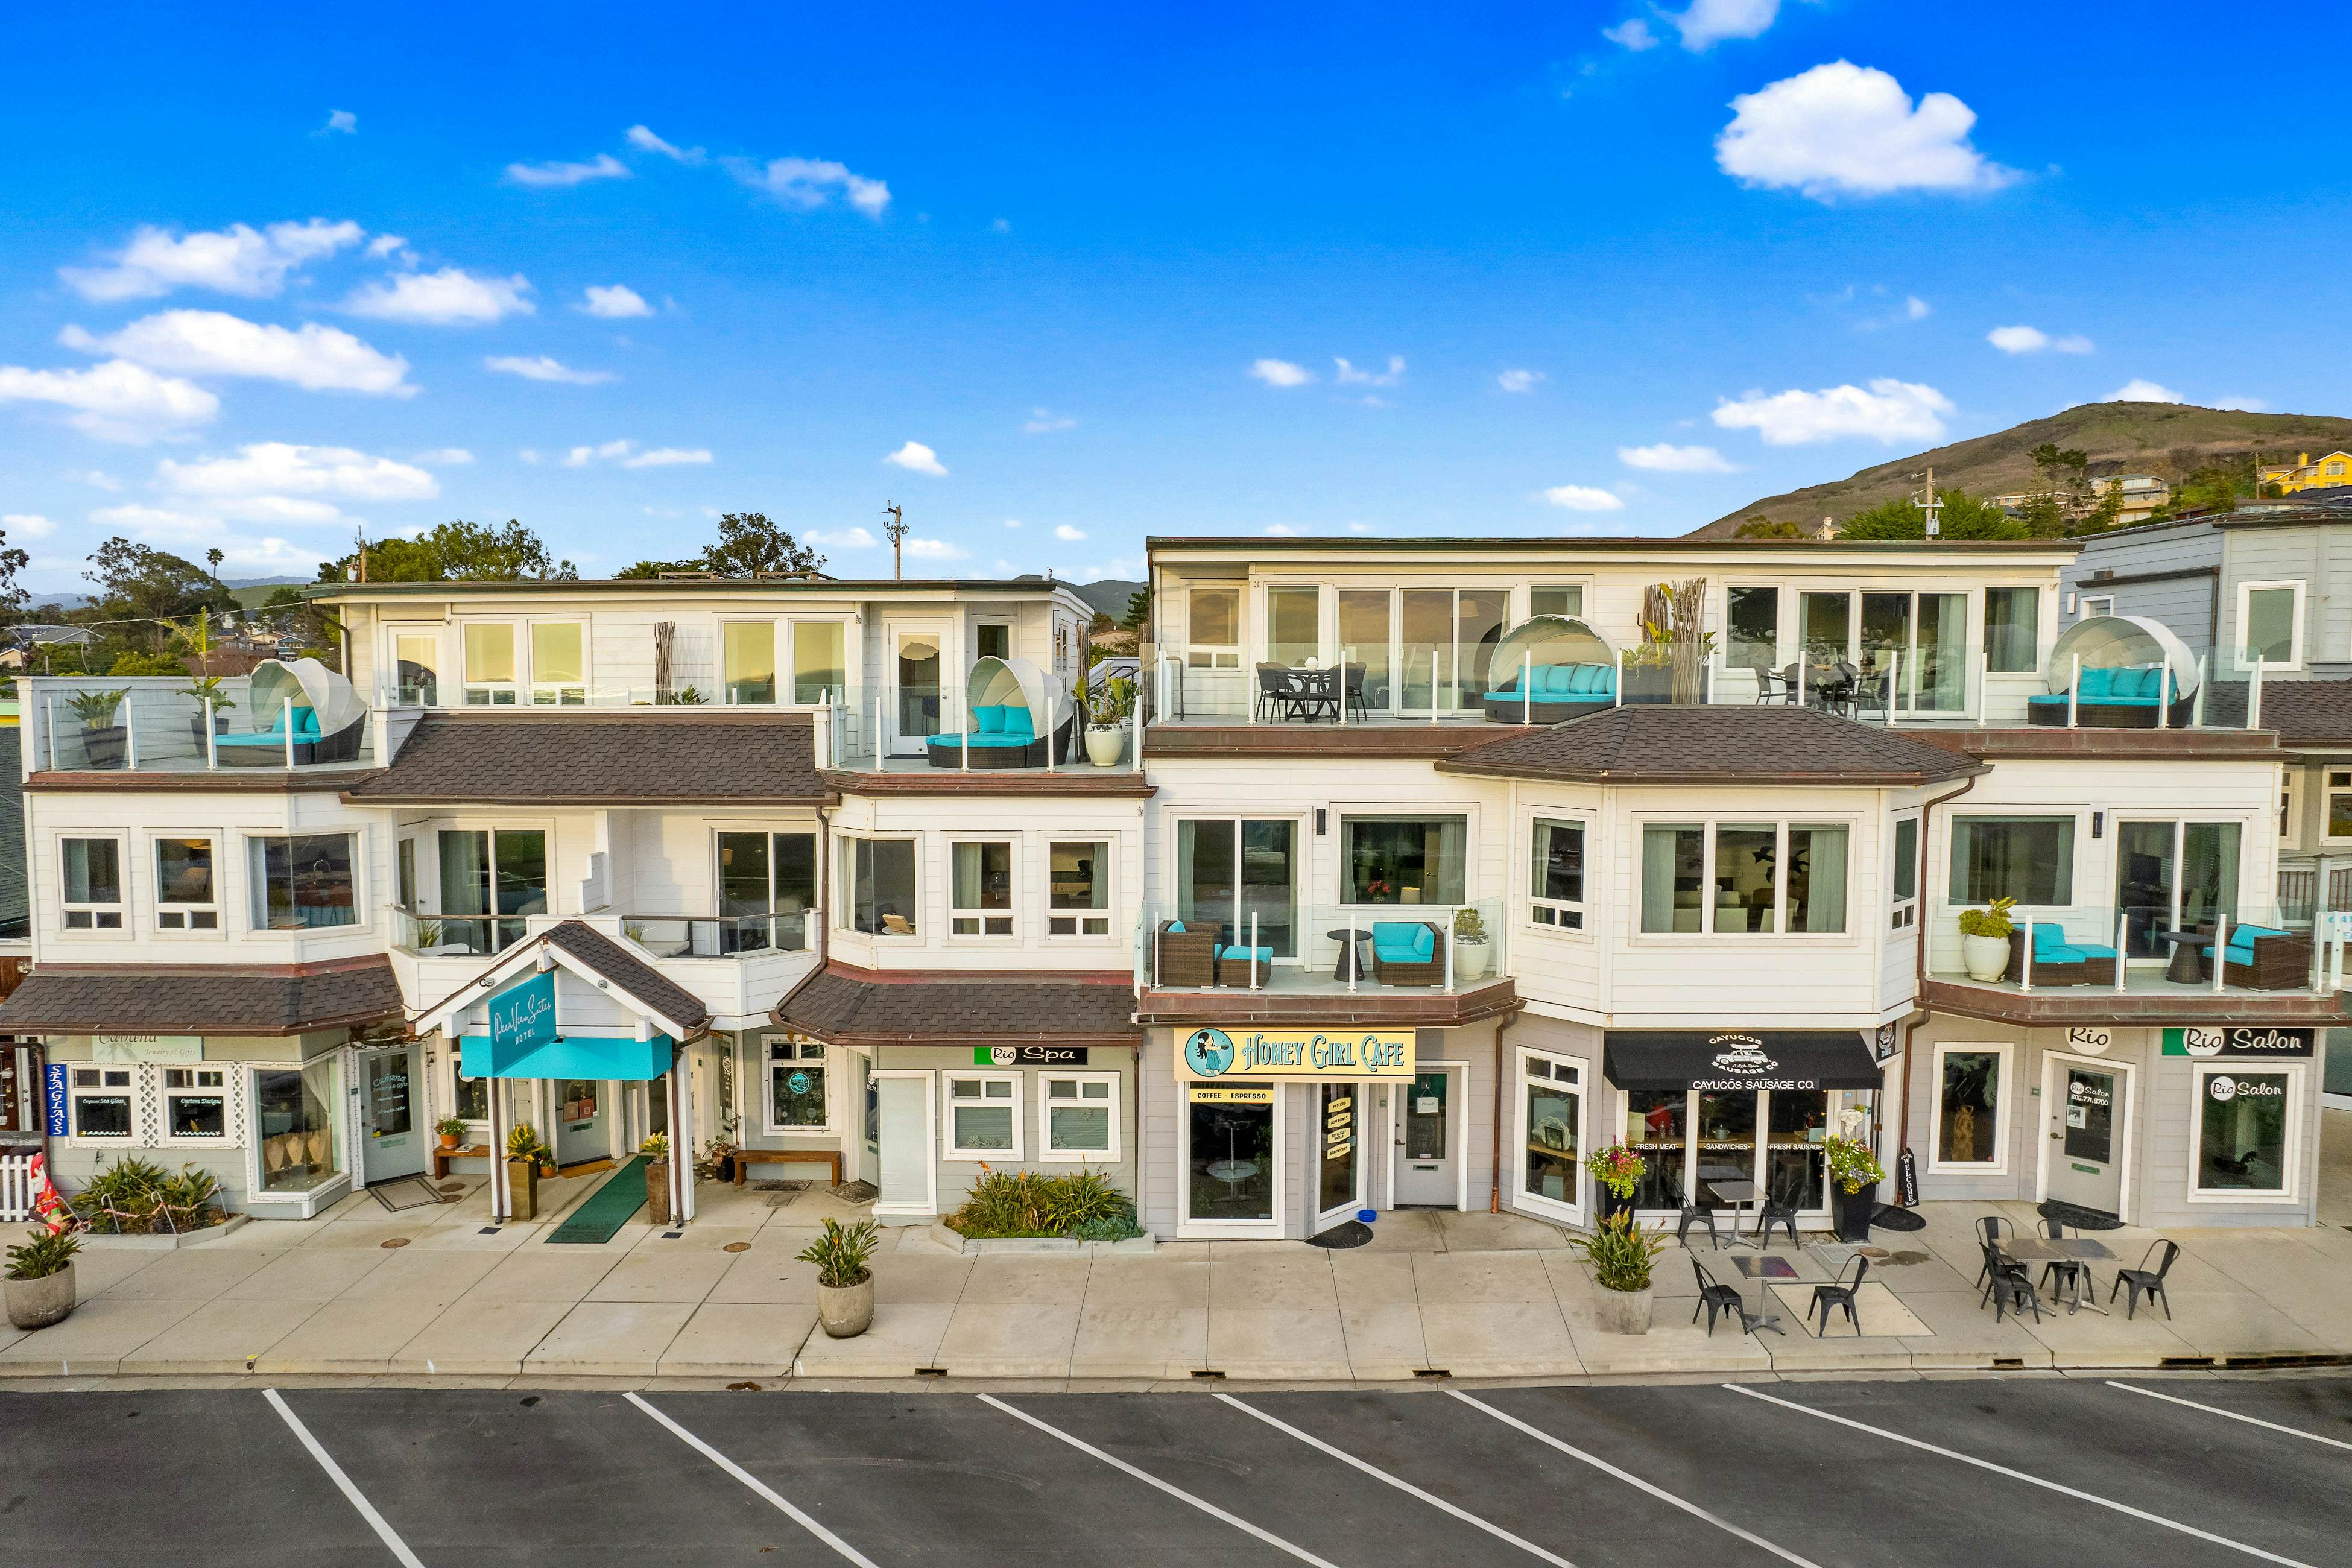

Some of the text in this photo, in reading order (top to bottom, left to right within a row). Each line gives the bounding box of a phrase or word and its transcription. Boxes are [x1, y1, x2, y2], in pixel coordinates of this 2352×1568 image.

[528, 994, 551, 1024] Suites
[515, 1028, 535, 1045] HOTEL
[1709, 1035, 1763, 1045] CAYUCOS
[2070, 1028, 2108, 1045] Rio
[2186, 1028, 2302, 1049] Rio Salon
[145, 1048, 169, 1057] Jewelry
[179, 1048, 196, 1057] Gifts
[993, 1046, 1076, 1063] Rio Spa
[1241, 1033, 1405, 1072] HONEY GIRL CAFE
[1711, 1061, 1765, 1074] SAUSAGE
[1766, 1061, 1778, 1070] CO
[373, 1073, 406, 1087] Cabana
[1693, 1081, 1742, 1089] CAYUCOS
[1745, 1080, 1794, 1089] SAUSAGE
[2085, 1086, 2110, 1097] Salon
[2213, 1082, 2282, 1095] Rio Salon
[2071, 1094, 2108, 1105] 805.771.8700
[1904, 1159, 1914, 1201] WELCOME
